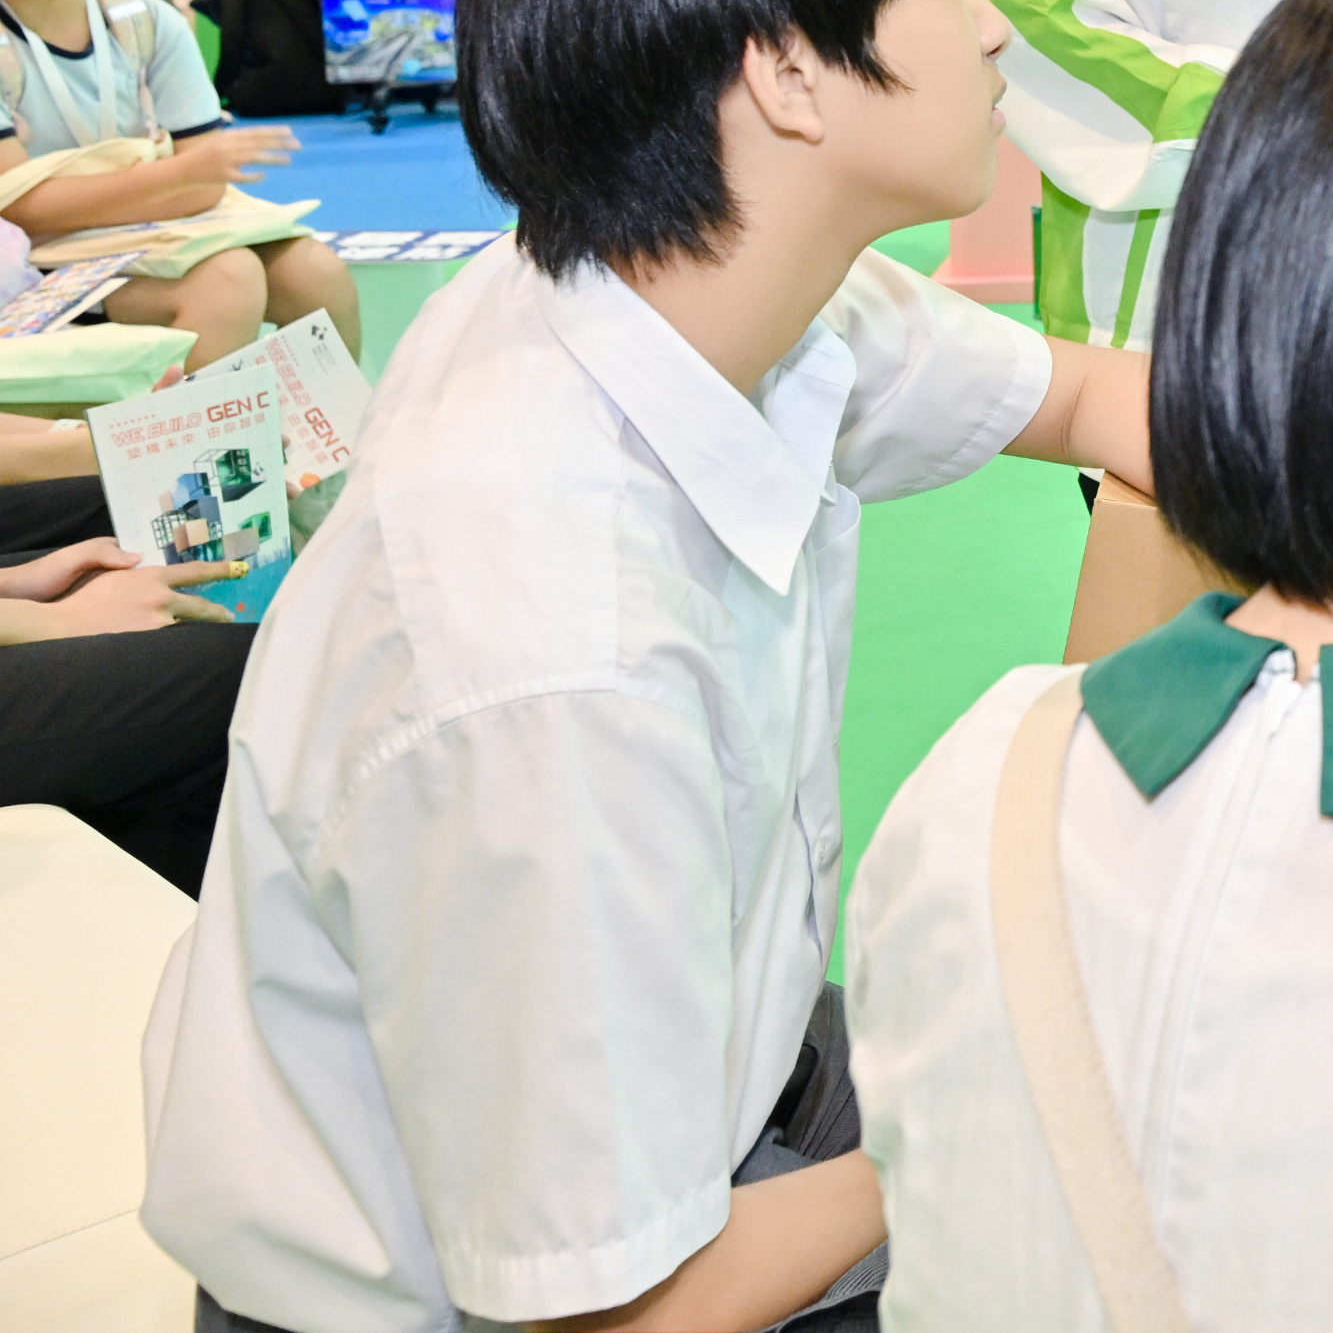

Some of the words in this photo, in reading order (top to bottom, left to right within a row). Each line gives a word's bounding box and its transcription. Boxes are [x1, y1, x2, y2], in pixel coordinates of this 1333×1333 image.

[110, 427, 146, 448] WE
[147, 412, 202, 440] BUILD
[206, 396, 253, 423] GEN
[256, 391, 270, 409] C
[304, 407, 340, 447] GEN
